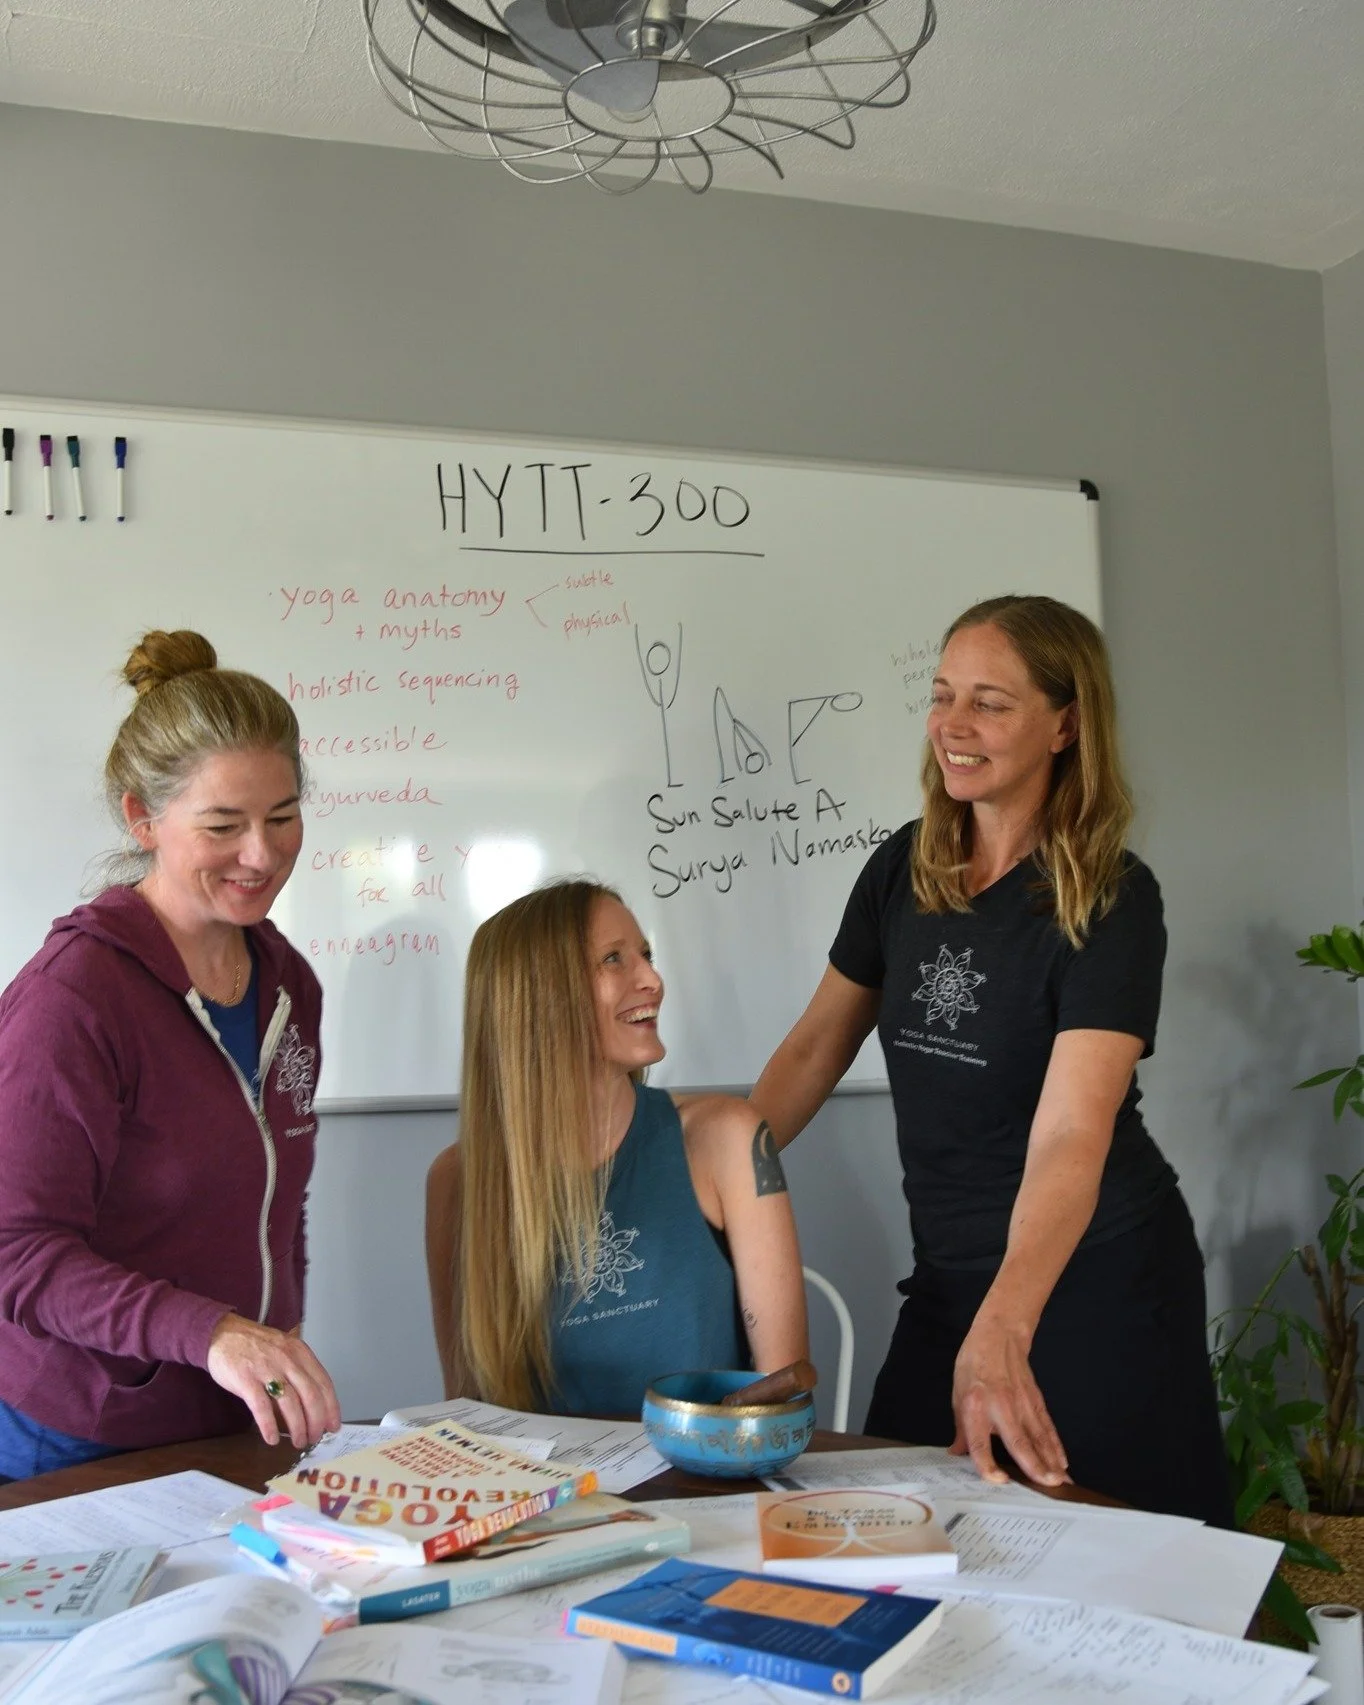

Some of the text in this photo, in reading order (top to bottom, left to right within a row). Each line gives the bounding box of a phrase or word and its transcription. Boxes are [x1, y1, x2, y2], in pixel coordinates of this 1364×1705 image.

[437, 462, 751, 541] HYTT-300
[565, 569, 614, 588] subtle
[280, 586, 506, 625] yoga anatomy
[563, 601, 631, 644] physical
[379, 620, 462, 650] myths
[288, 669, 520, 706] holistic sequencing
[300, 726, 447, 758] accessible
[301, 777, 442, 818] ayurveda
[647, 788, 846, 834] Sun Salute A
[411, 873, 447, 901] all
[647, 844, 749, 899] Surya
[899, 1027, 980, 1052] YOGA SANCTUARY
[592, 1298, 660, 1321] SANCTUARY
[434, 1427, 506, 1462] HEYMAN
[297, 1468, 532, 1504] REVOLUTION
[317, 1491, 478, 1527] YOGA
[402, 1591, 441, 1607] LASATER
